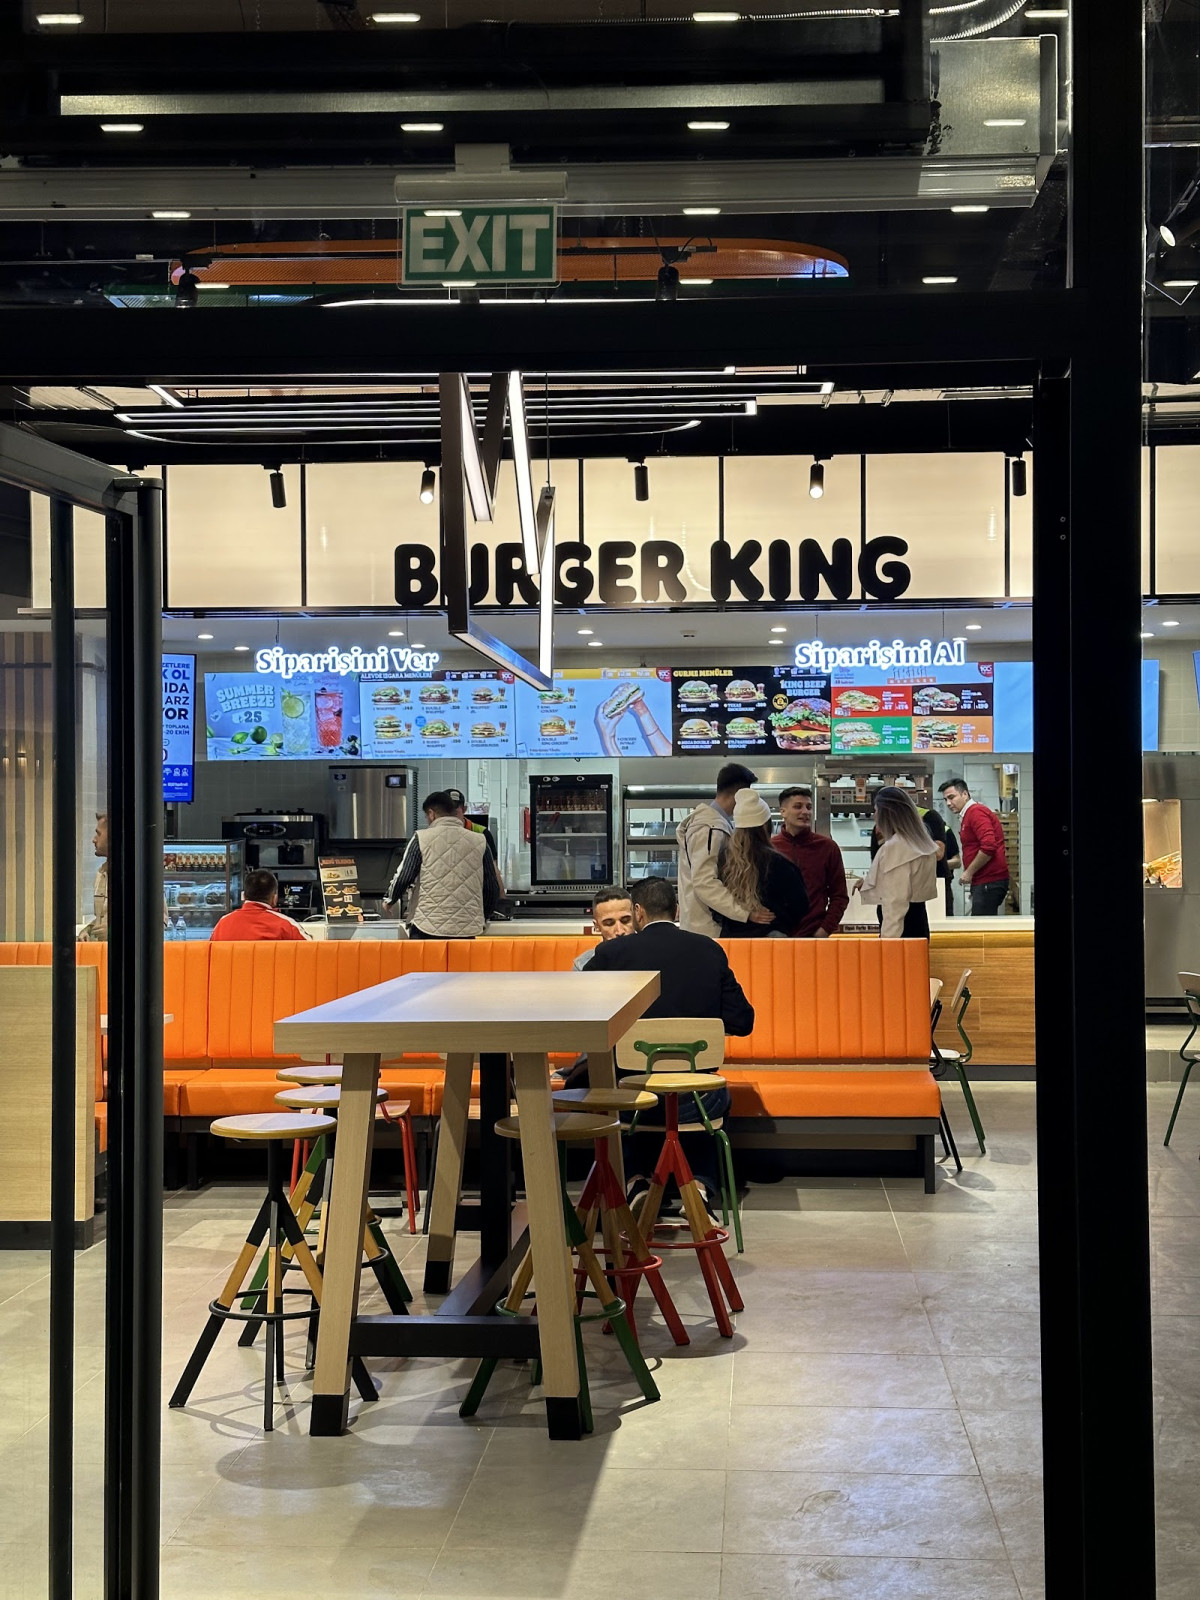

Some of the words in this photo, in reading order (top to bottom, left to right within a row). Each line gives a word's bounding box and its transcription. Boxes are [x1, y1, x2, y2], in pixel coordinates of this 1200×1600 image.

[409, 214, 550, 273] EXIT
[394, 541, 686, 605] BURGER
[711, 536, 911, 602] KING
[256, 646, 389, 679] Siparişini
[390, 649, 440, 671] Ver
[795, 639, 932, 673] Siparişini
[933, 638, 966, 666] Al
[171, 669, 190, 680] OL
[699, 668, 734, 677] MENÜLER
[804, 680, 827, 689] BEEF
[164, 695, 190, 705] ARZ
[216, 684, 275, 703] SUMMER
[786, 688, 821, 697] BURGER
[221, 695, 275, 713] BREEZE
[163, 707, 189, 720] OR
